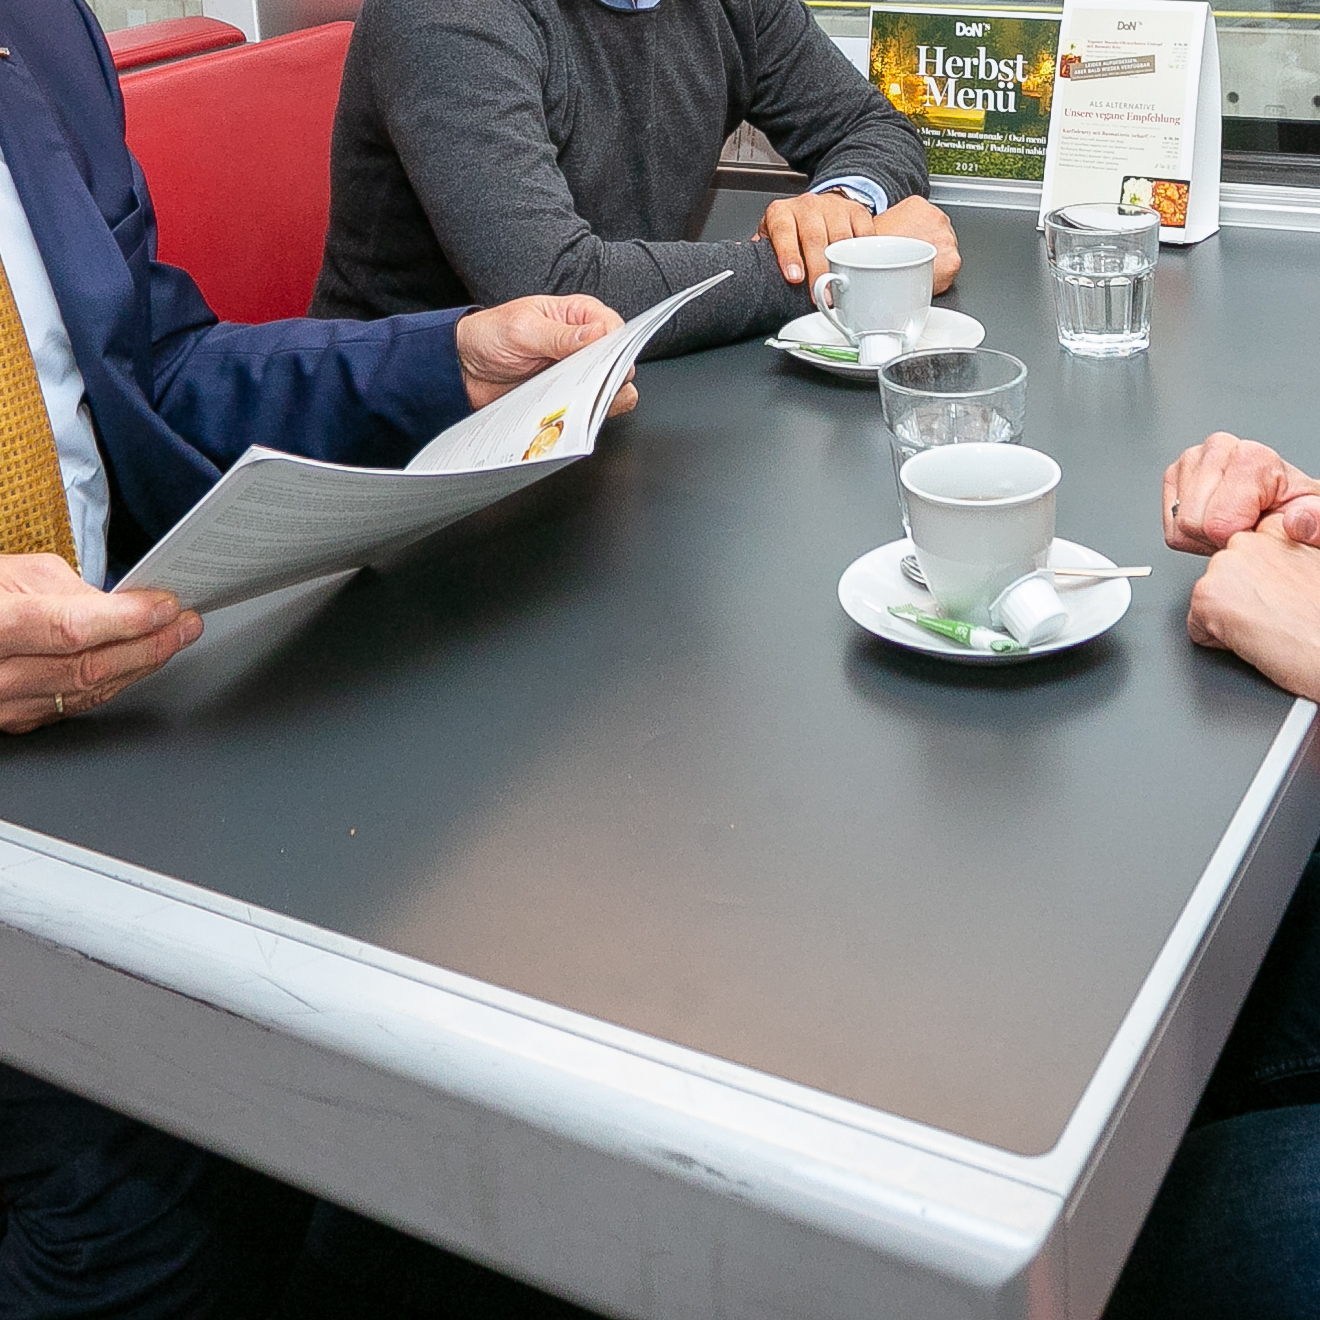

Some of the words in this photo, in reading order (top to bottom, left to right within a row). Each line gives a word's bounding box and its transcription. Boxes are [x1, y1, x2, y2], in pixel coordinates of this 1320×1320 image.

[916, 45, 1028, 83] Herbst
[1074, 67, 1088, 75] ABER
[1088, 66, 1101, 74] BALD
[1101, 64, 1120, 72] WIEDER
[923, 76, 1017, 113] Menü
[1105, 101, 1156, 111] ALTERNATIVE
[1064, 108, 1094, 119] Unsere
[1095, 110, 1125, 122] vegane
[1126, 111, 1181, 126] Empfehlung
[955, 162, 978, 172] 2021
